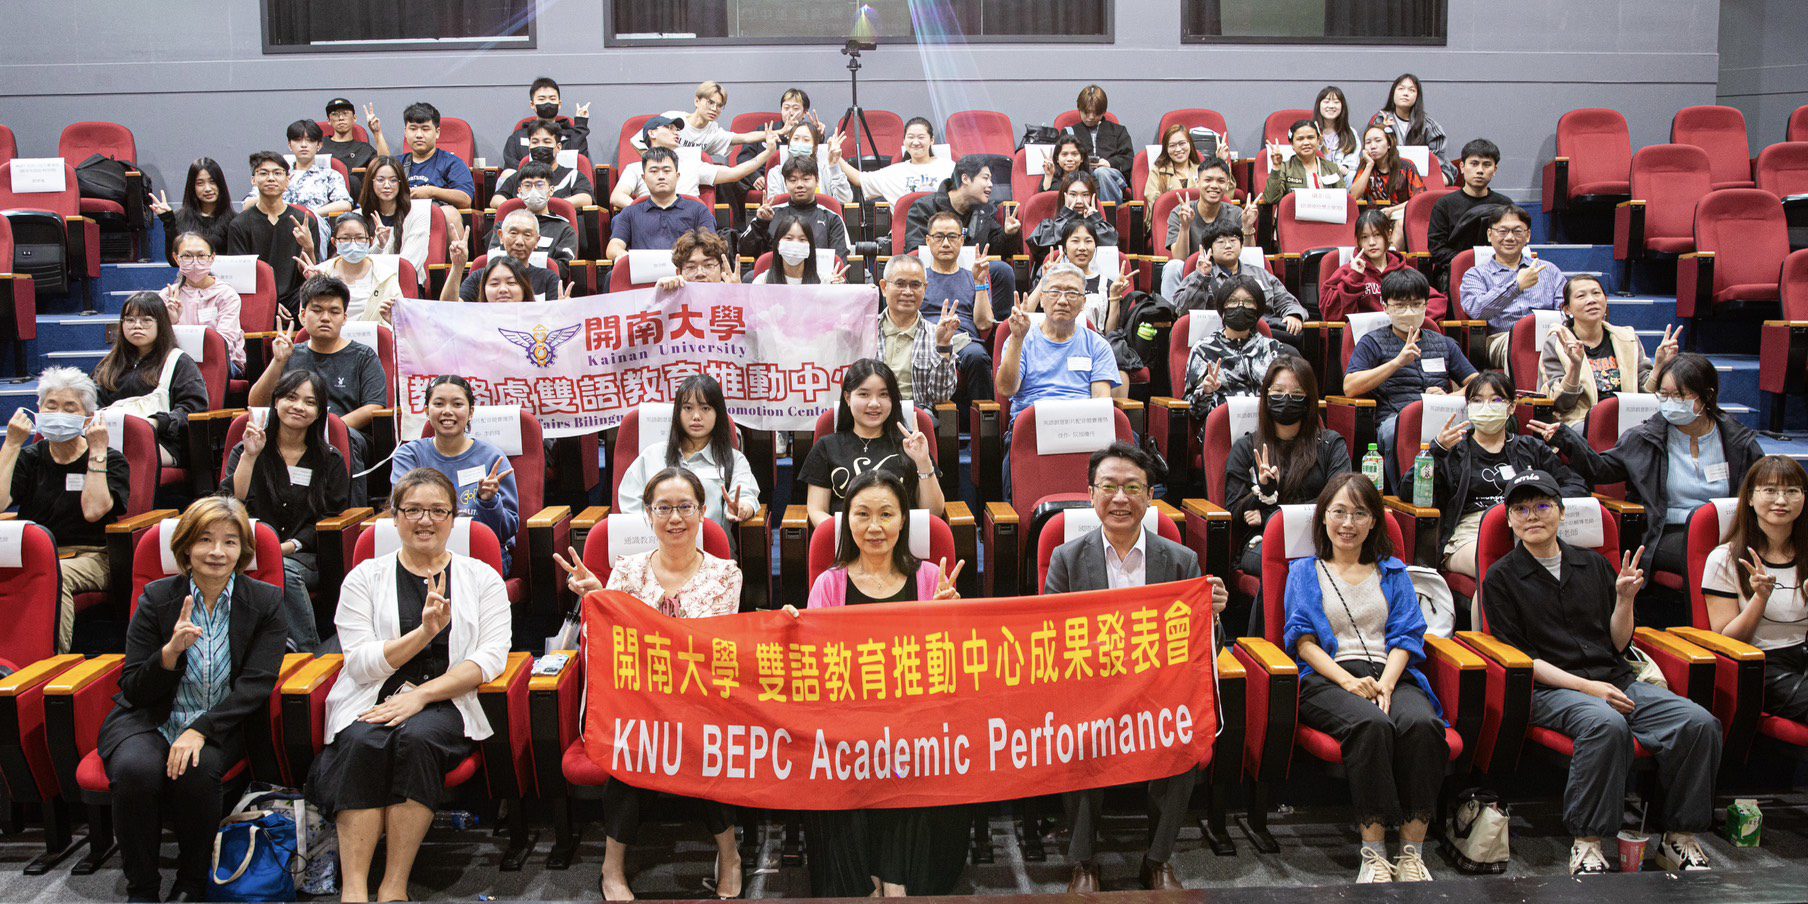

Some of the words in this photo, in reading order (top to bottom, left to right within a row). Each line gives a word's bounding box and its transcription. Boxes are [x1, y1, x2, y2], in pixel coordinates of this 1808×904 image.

[585, 304, 746, 352] 開南大學
[588, 350, 648, 367] Kainan
[659, 341, 747, 358] University
[724, 405, 784, 417] omotion
[612, 625, 740, 699] 開南大學
[756, 600, 1192, 703] 雙語教育推動中心成果發表會
[611, 718, 683, 776] KNU
[702, 724, 792, 780] BEPC
[809, 722, 971, 781] Academic
[988, 704, 1193, 772] Performance
